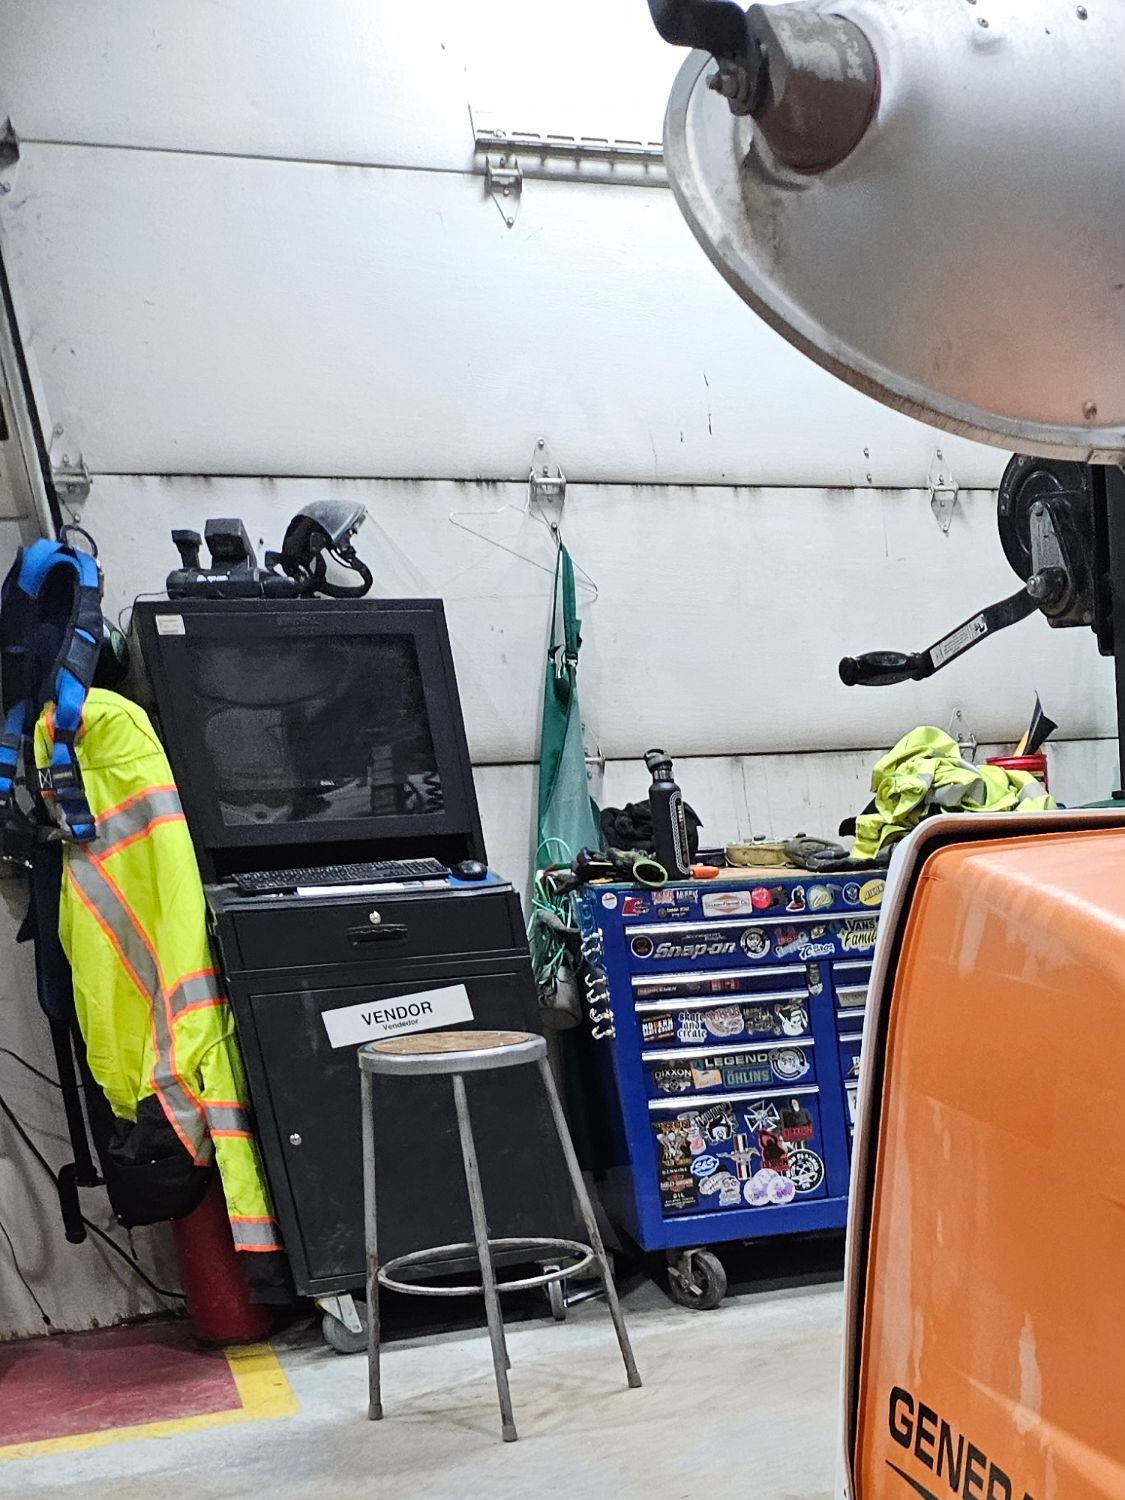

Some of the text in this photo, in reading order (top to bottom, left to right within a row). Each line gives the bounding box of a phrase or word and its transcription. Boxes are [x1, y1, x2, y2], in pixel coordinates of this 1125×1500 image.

[847, 920, 876, 932] VANS
[653, 941, 738, 960] Snap-on
[361, 1001, 433, 1026] VENDOR
[382, 1019, 419, 1031] Vendedor
[704, 1053, 768, 1069] LEGEND
[654, 1068, 692, 1079] DIXXON
